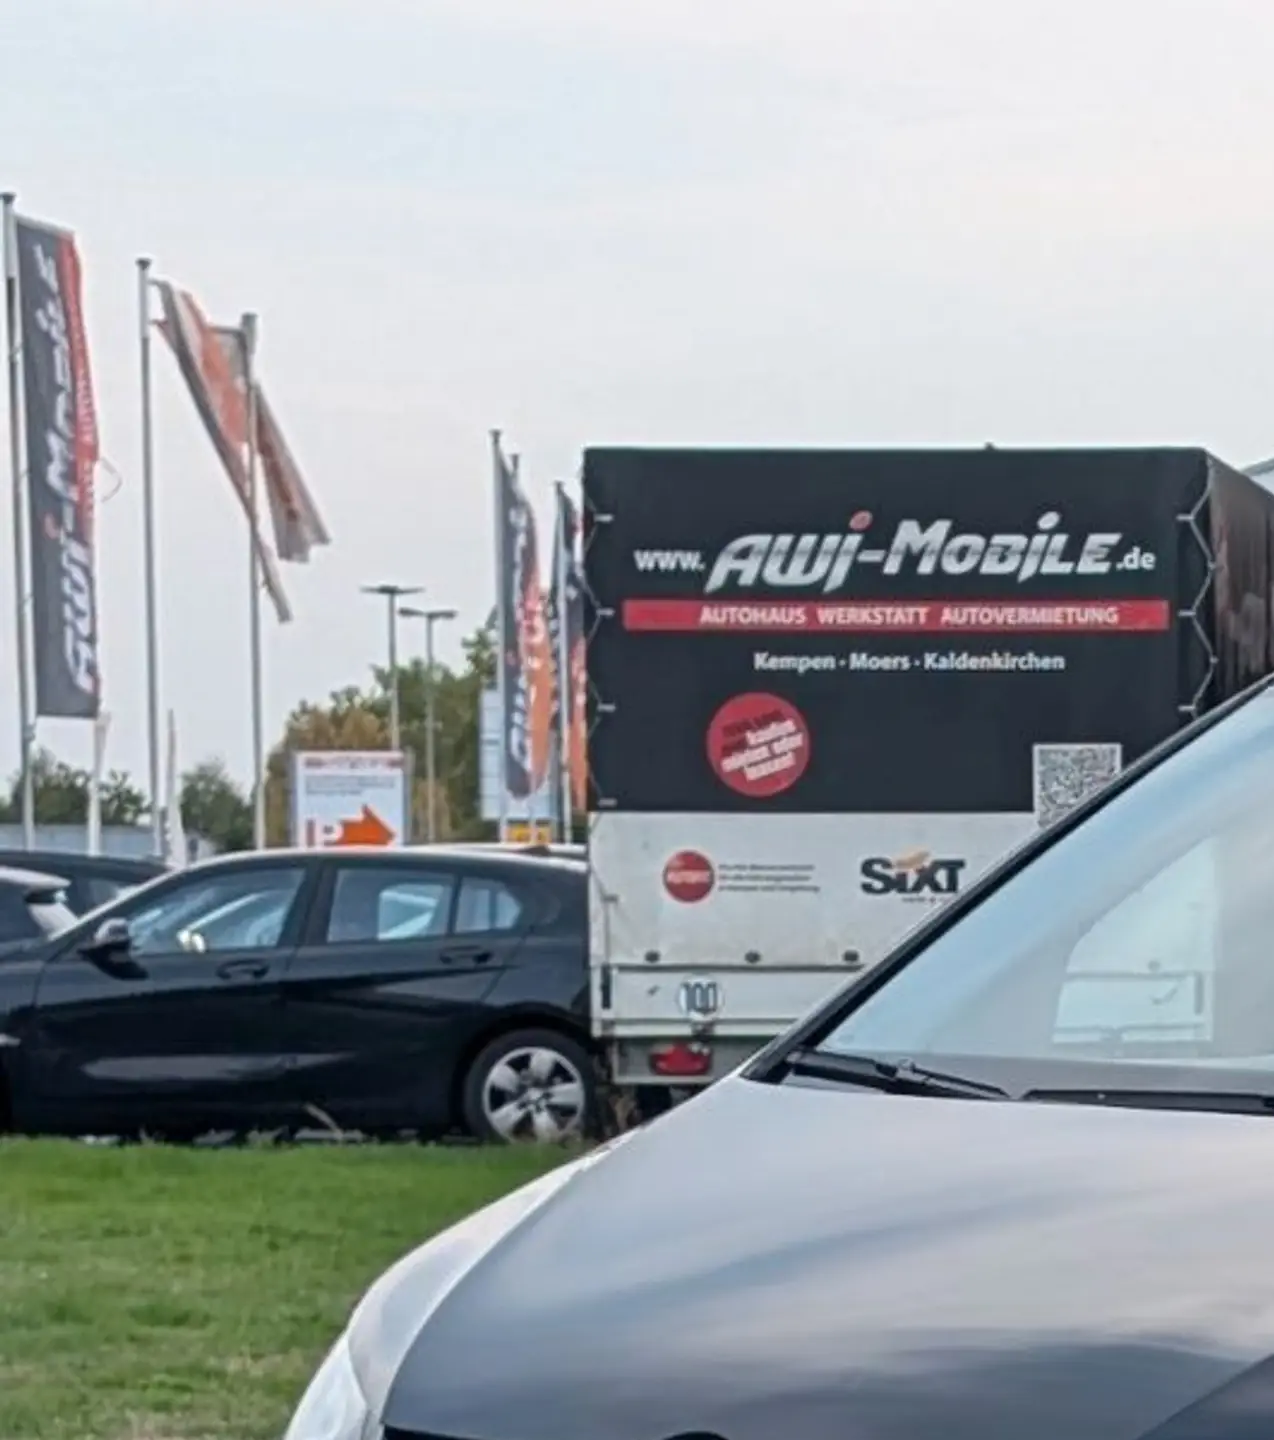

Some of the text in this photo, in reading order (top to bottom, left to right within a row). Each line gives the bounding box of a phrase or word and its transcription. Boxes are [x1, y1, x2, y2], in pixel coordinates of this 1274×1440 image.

[700, 605, 1120, 626] AUTOHAUS WERKSTATT AUTOVERMIETUNG
[753, 651, 1066, 676] Kempen Moers Kaldenkirchen
[680, 981, 718, 1016] 100
